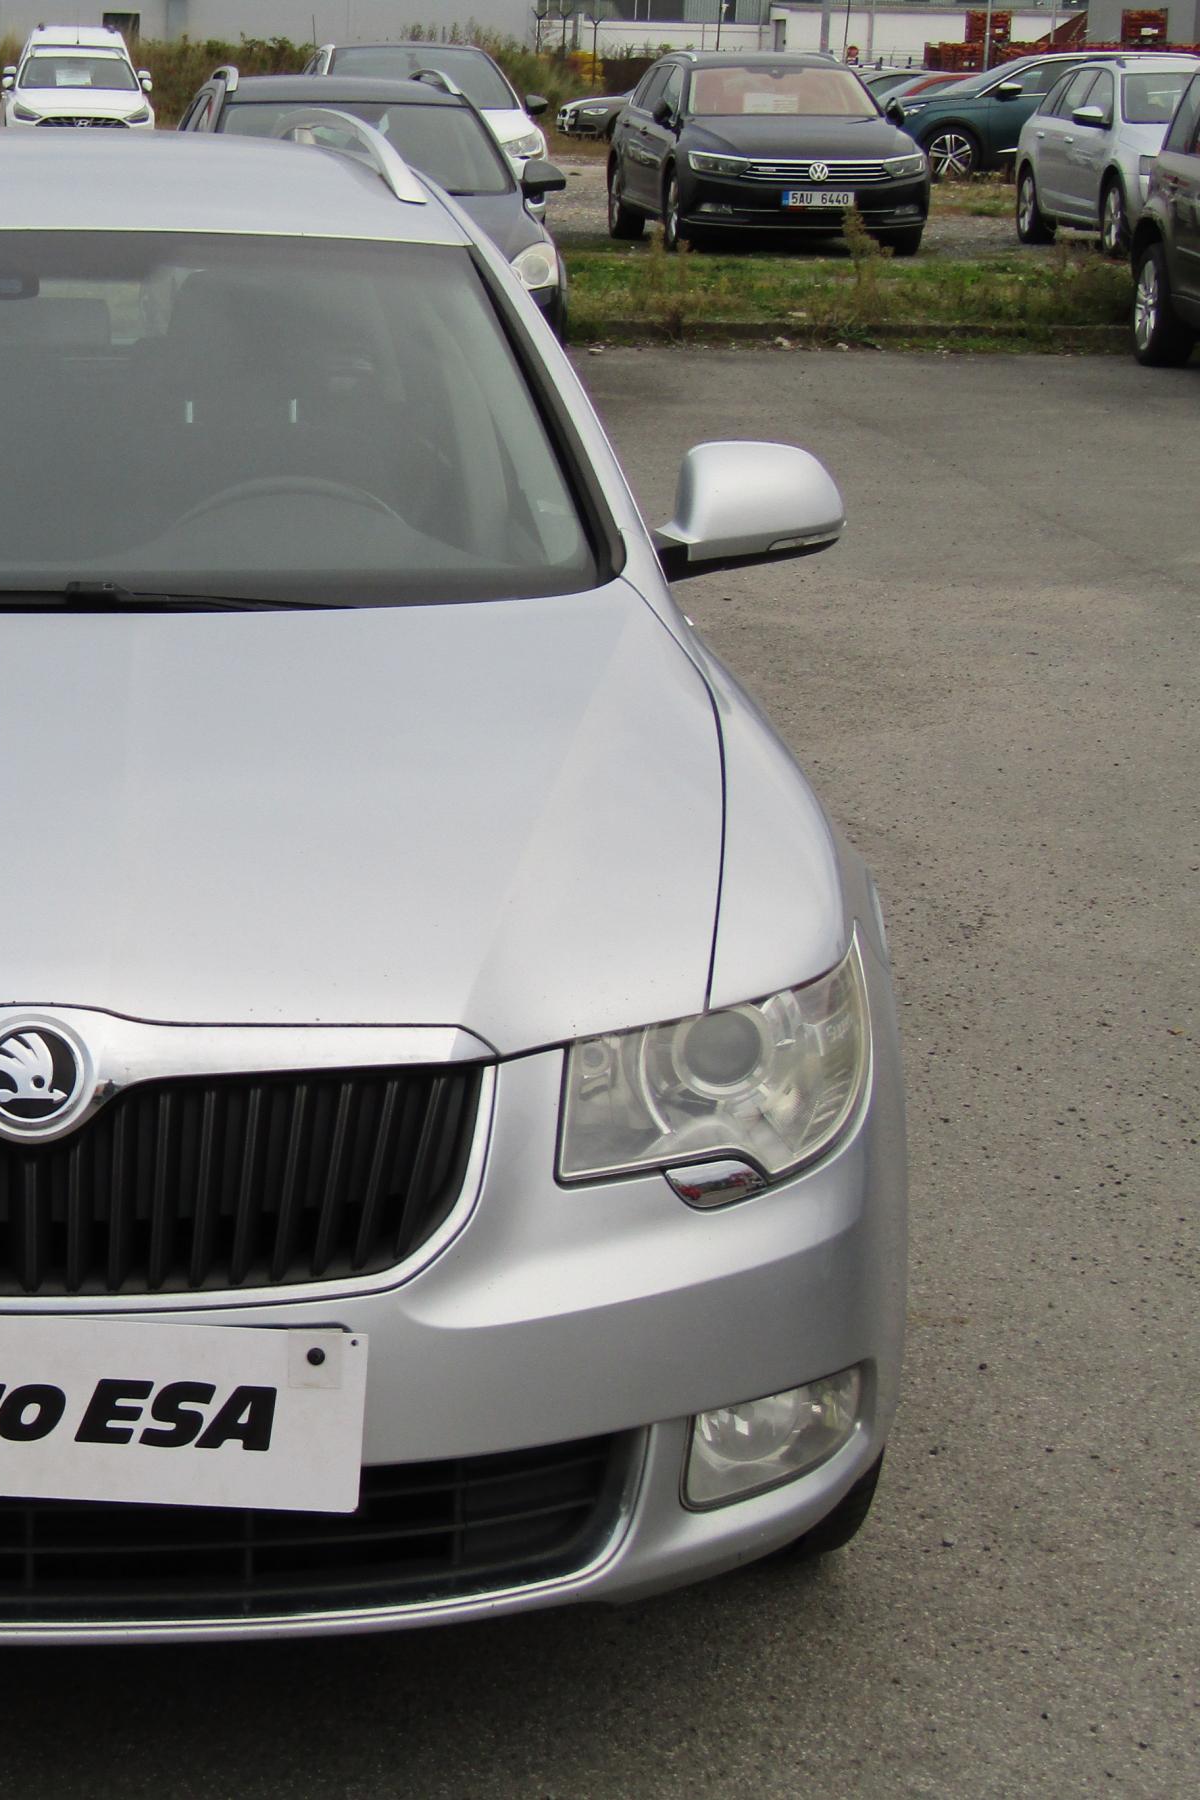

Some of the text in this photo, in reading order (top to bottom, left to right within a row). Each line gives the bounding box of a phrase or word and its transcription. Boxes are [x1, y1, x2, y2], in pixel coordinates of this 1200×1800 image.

[791, 193, 849, 205] 5AU 6440
[74, 1379, 277, 1451] ESA
